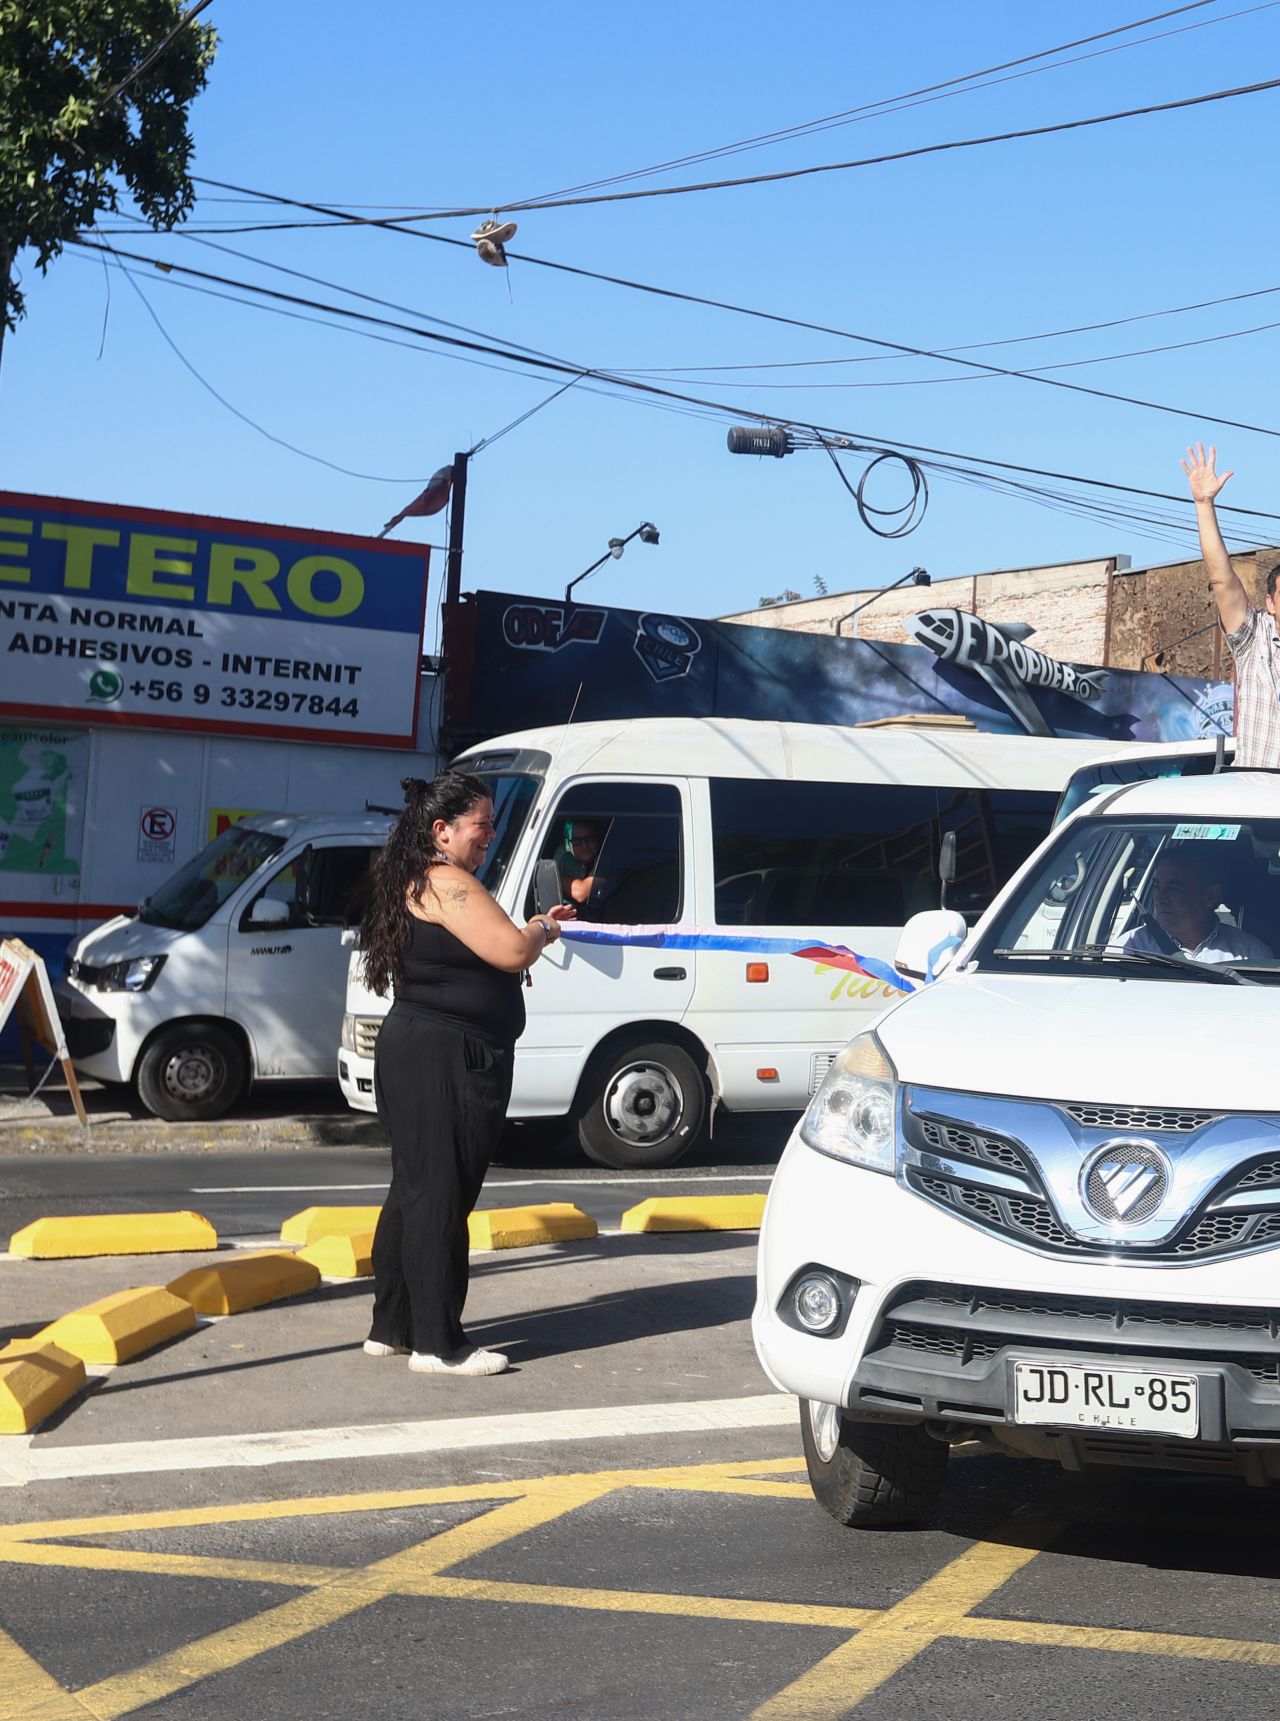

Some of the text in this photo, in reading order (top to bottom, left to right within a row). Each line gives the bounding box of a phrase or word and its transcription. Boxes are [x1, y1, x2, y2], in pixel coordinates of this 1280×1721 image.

[70, 607, 204, 638] NORMAL
[8, 633, 194, 669] ADHESIVOS
[221, 653, 362, 685] INTERNIT
[129, 680, 360, 718] +56 9 33297844
[1078, 1413, 1137, 1427] CHILE
